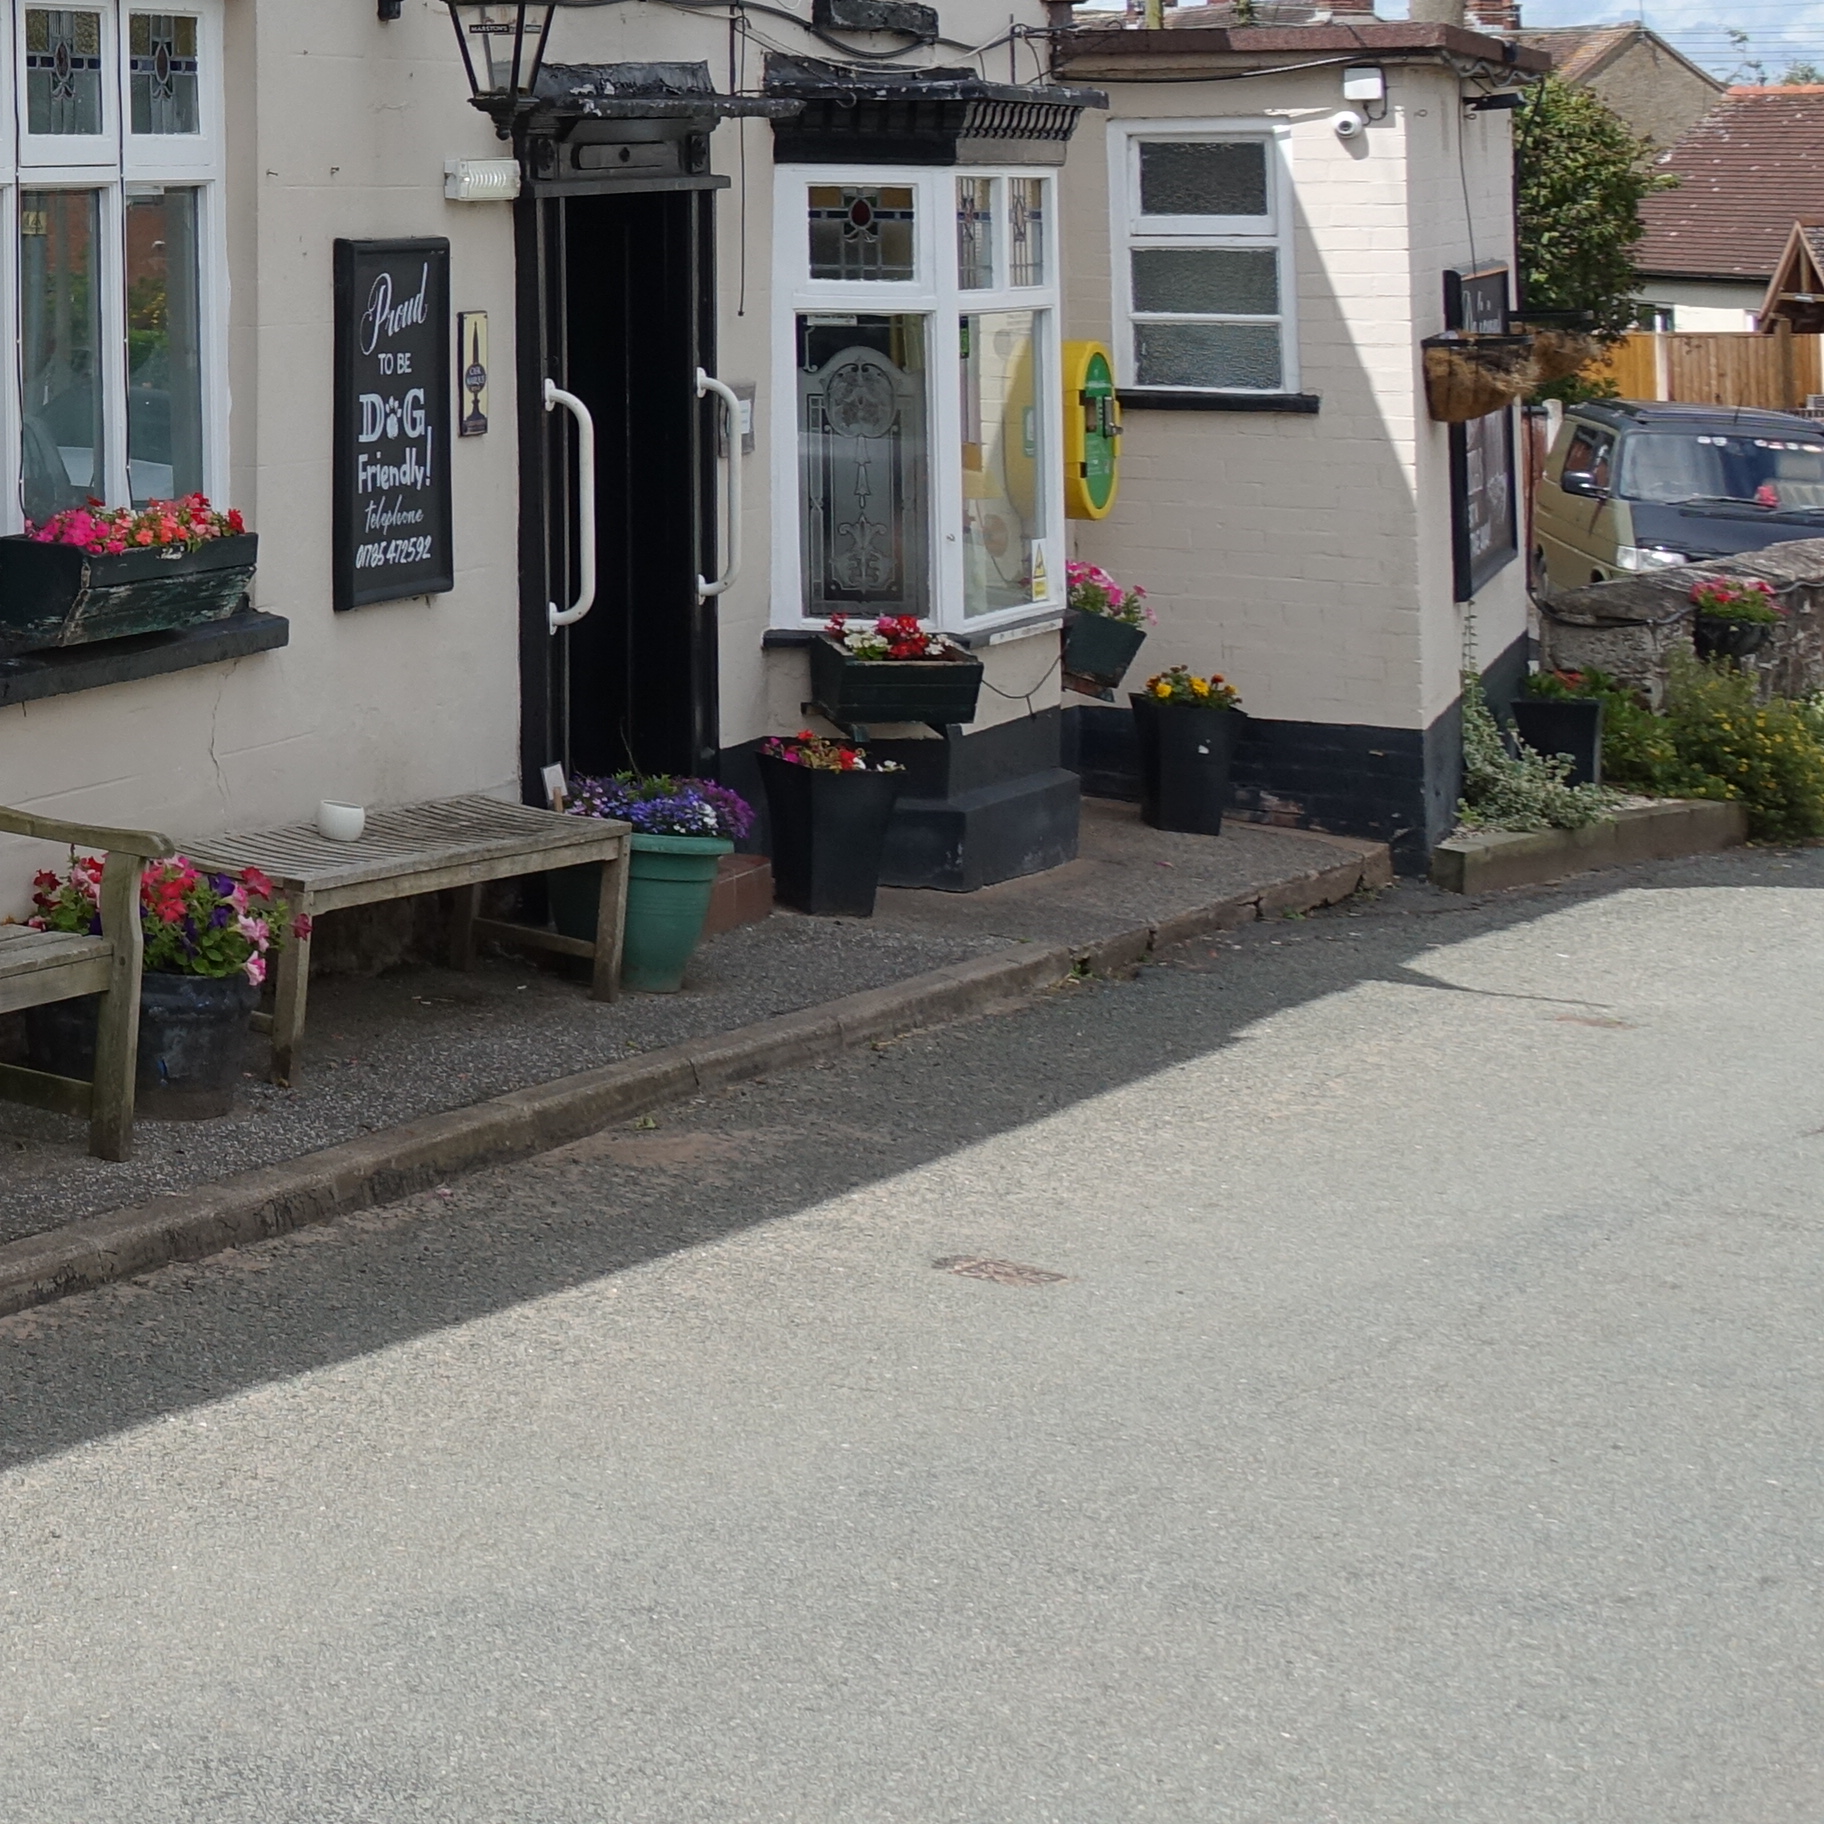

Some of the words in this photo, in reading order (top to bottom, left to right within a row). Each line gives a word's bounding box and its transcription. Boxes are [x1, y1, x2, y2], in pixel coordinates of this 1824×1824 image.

[360, 262, 428, 355] Proud
[378, 353, 394, 375] TO
[396, 353, 412, 374] BE
[358, 388, 425, 442] DG
[357, 426, 432, 494] Friendly!
[365, 494, 424, 535] telephone
